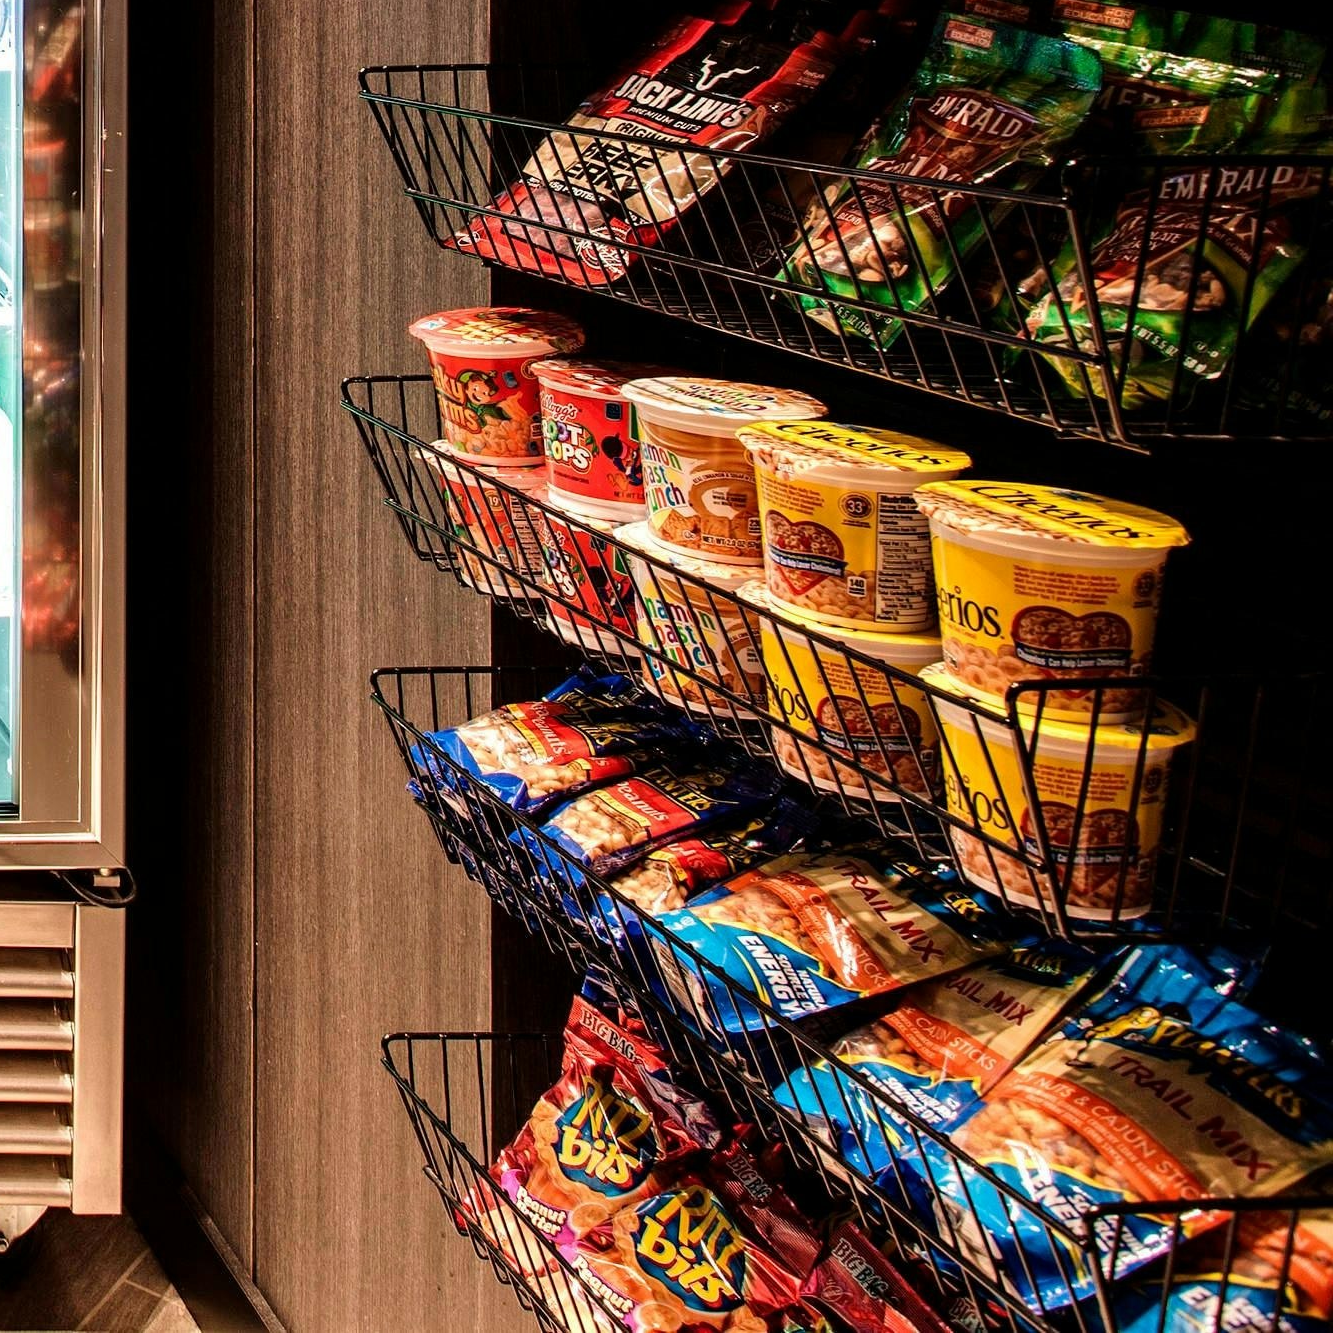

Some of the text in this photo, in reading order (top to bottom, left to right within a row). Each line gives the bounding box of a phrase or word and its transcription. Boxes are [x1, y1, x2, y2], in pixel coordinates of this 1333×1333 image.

[615, 74, 752, 128] JACK LINK'S
[627, 105, 702, 134] PREMIUM CUTS
[931, 94, 1026, 139] EMERALD
[1158, 166, 1298, 201] EMERALD
[777, 421, 951, 467] Cheerios
[970, 481, 1157, 540] Cheerios
[848, 578, 865, 589] 140
[887, 916, 941, 964] MIX
[739, 934, 798, 1016] ENERGY
[773, 952, 805, 994] SOURCE
[988, 990, 1037, 1028] MIX
[581, 1009, 638, 1062] BIG BAG
[946, 1037, 999, 1073] STICKS
[1090, 1100, 1159, 1159] CAJUN
[1110, 1053, 1197, 1122] TRAIL
[1193, 1114, 1277, 1182] MIX
[559, 1124, 640, 1185] bits
[516, 1185, 568, 1225] Peanut
[571, 1254, 634, 1313] Peanut
[637, 1216, 737, 1304] bits
[831, 1238, 889, 1302] BIG BAG
